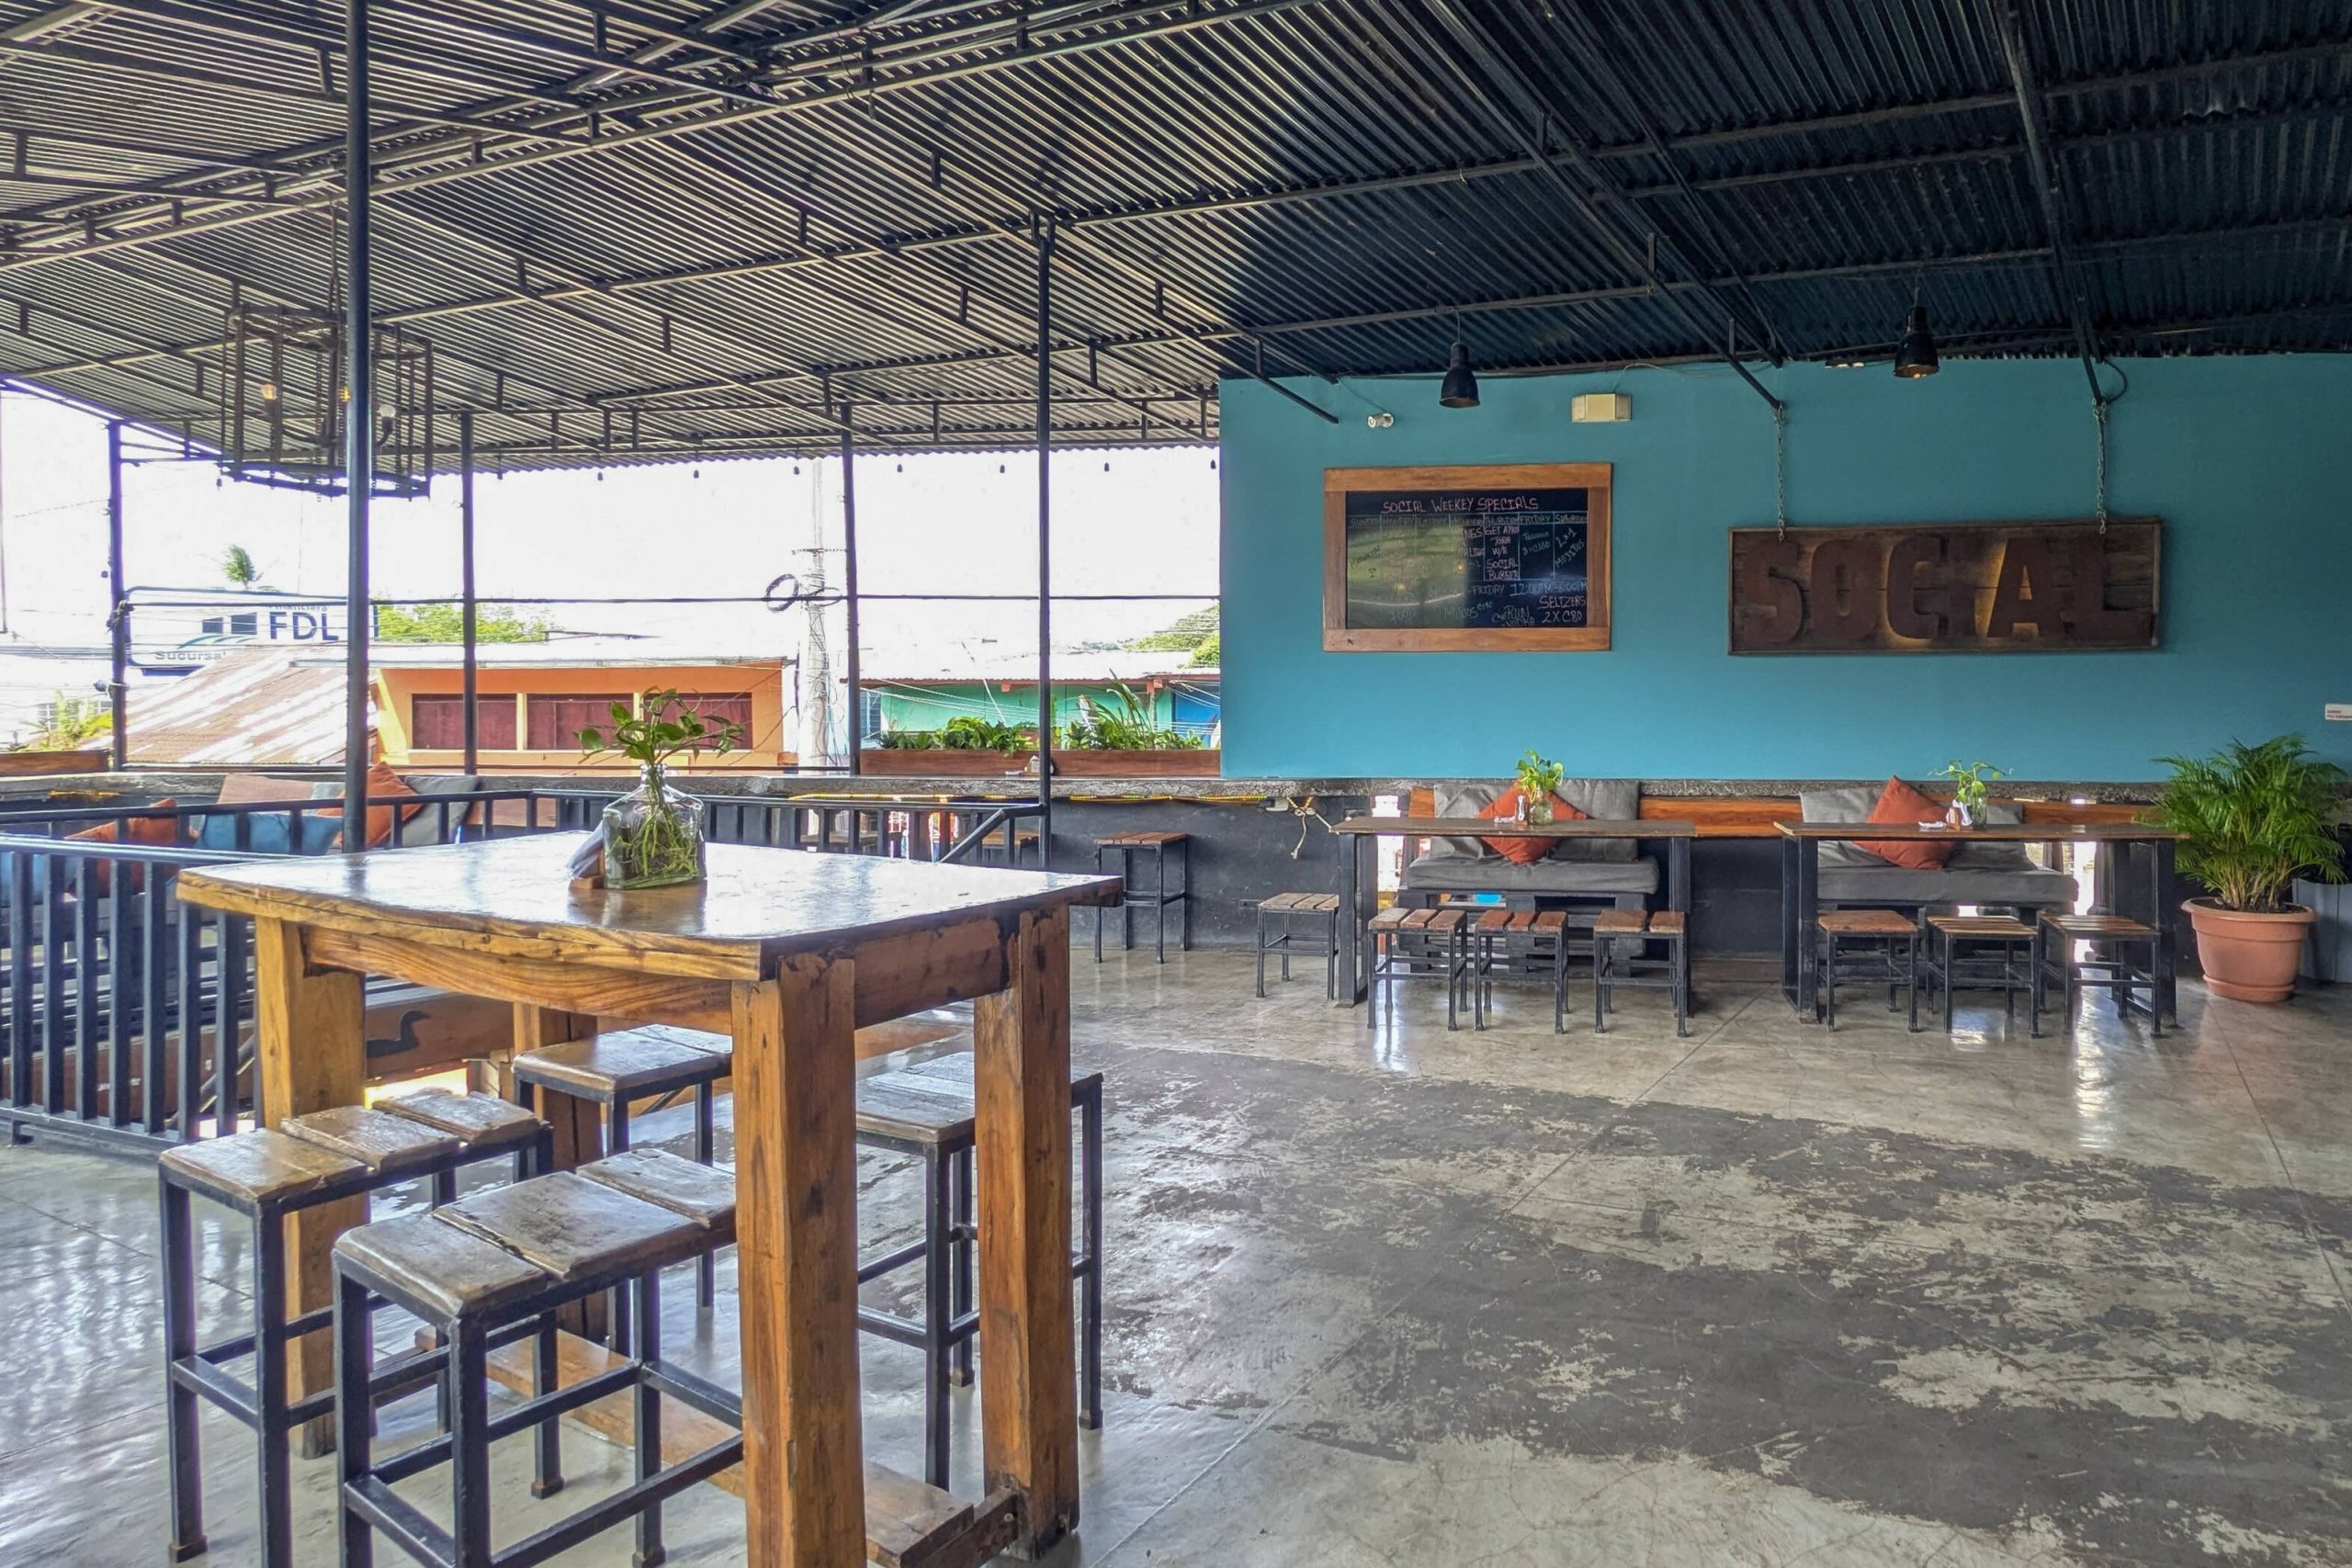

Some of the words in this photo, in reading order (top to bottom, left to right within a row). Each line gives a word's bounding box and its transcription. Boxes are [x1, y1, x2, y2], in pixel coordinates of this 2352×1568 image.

[1380, 501, 1426, 513] SOCIAL
[1476, 496, 1539, 512] SPECIALS
[1520, 515, 1551, 525] FRIDAY
[1486, 558, 1518, 570] SOCIAL
[1487, 570, 1519, 581] BURGER
[1734, 536, 2154, 641] SOCIAL
[269, 611, 339, 641] FDL
